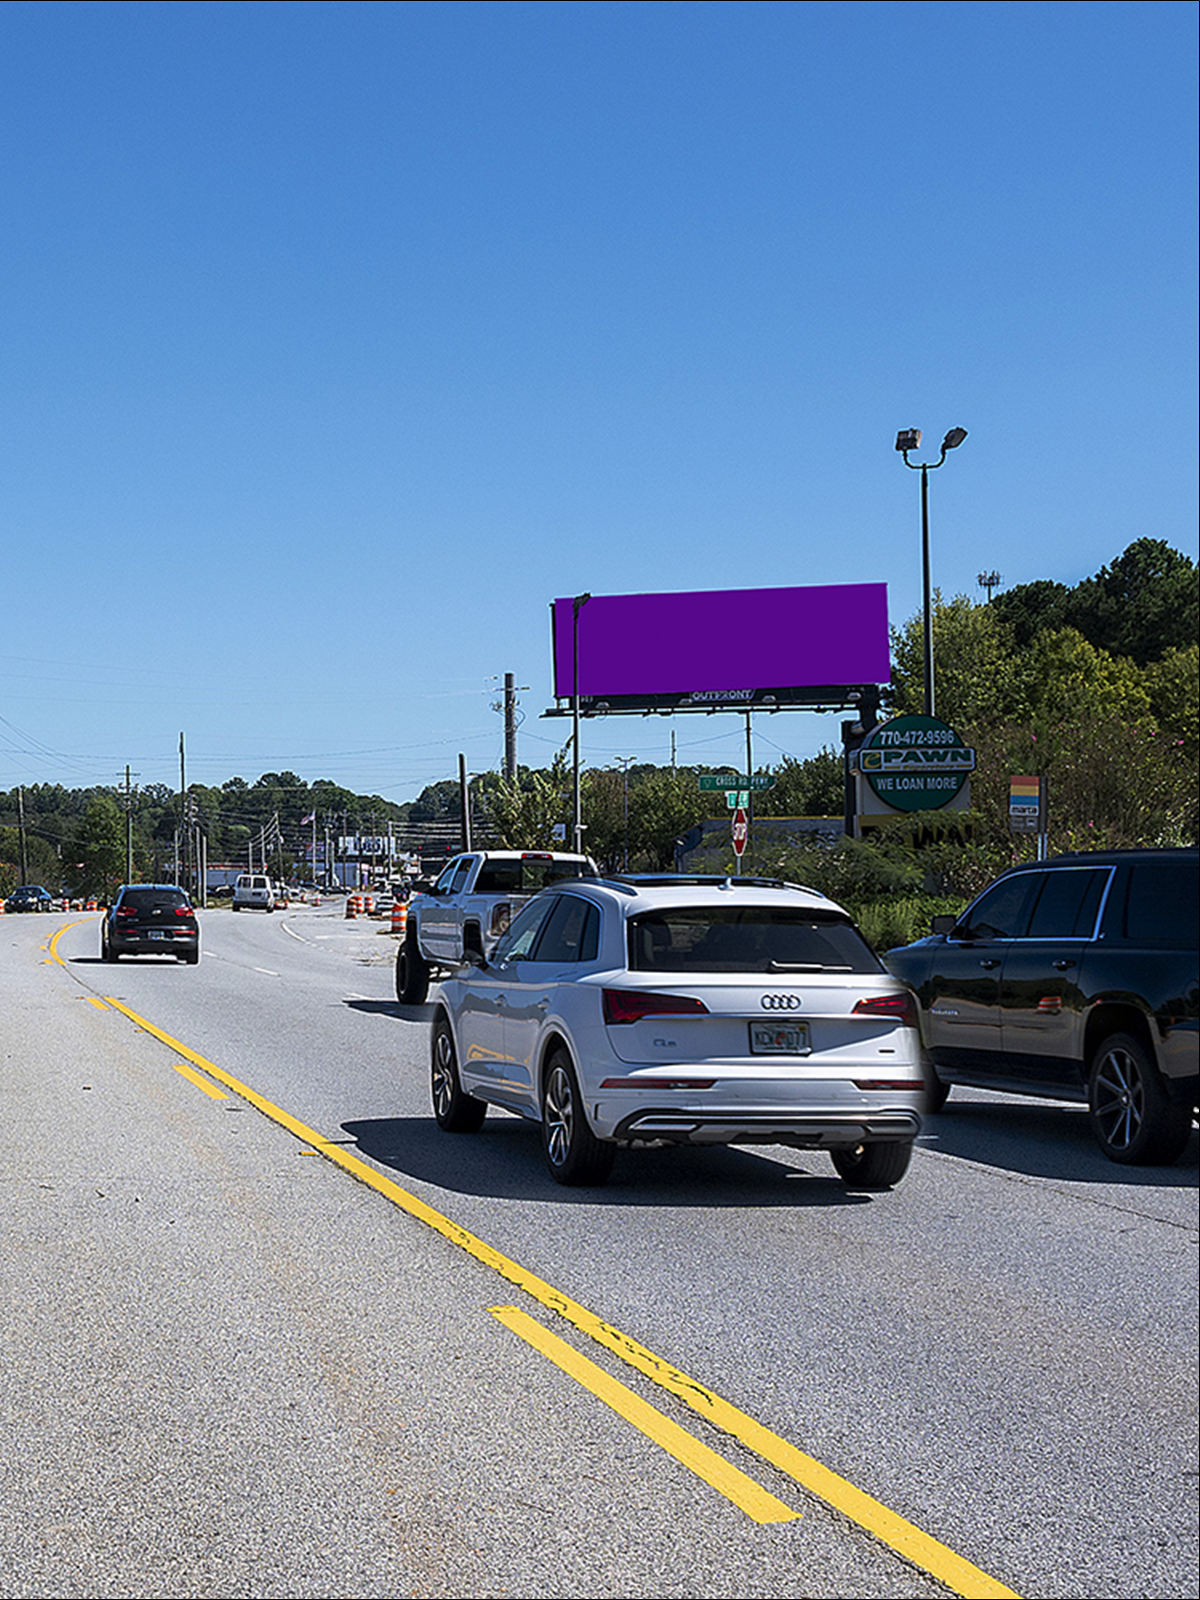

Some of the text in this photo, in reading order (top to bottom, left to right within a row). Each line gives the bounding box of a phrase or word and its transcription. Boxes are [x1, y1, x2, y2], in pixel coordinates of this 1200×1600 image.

[692, 689, 752, 701] OUTFRONT
[880, 730, 955, 746] 770-472-9596
[884, 750, 969, 763] PAWN
[877, 777, 958, 790] WE LOAN MORE
